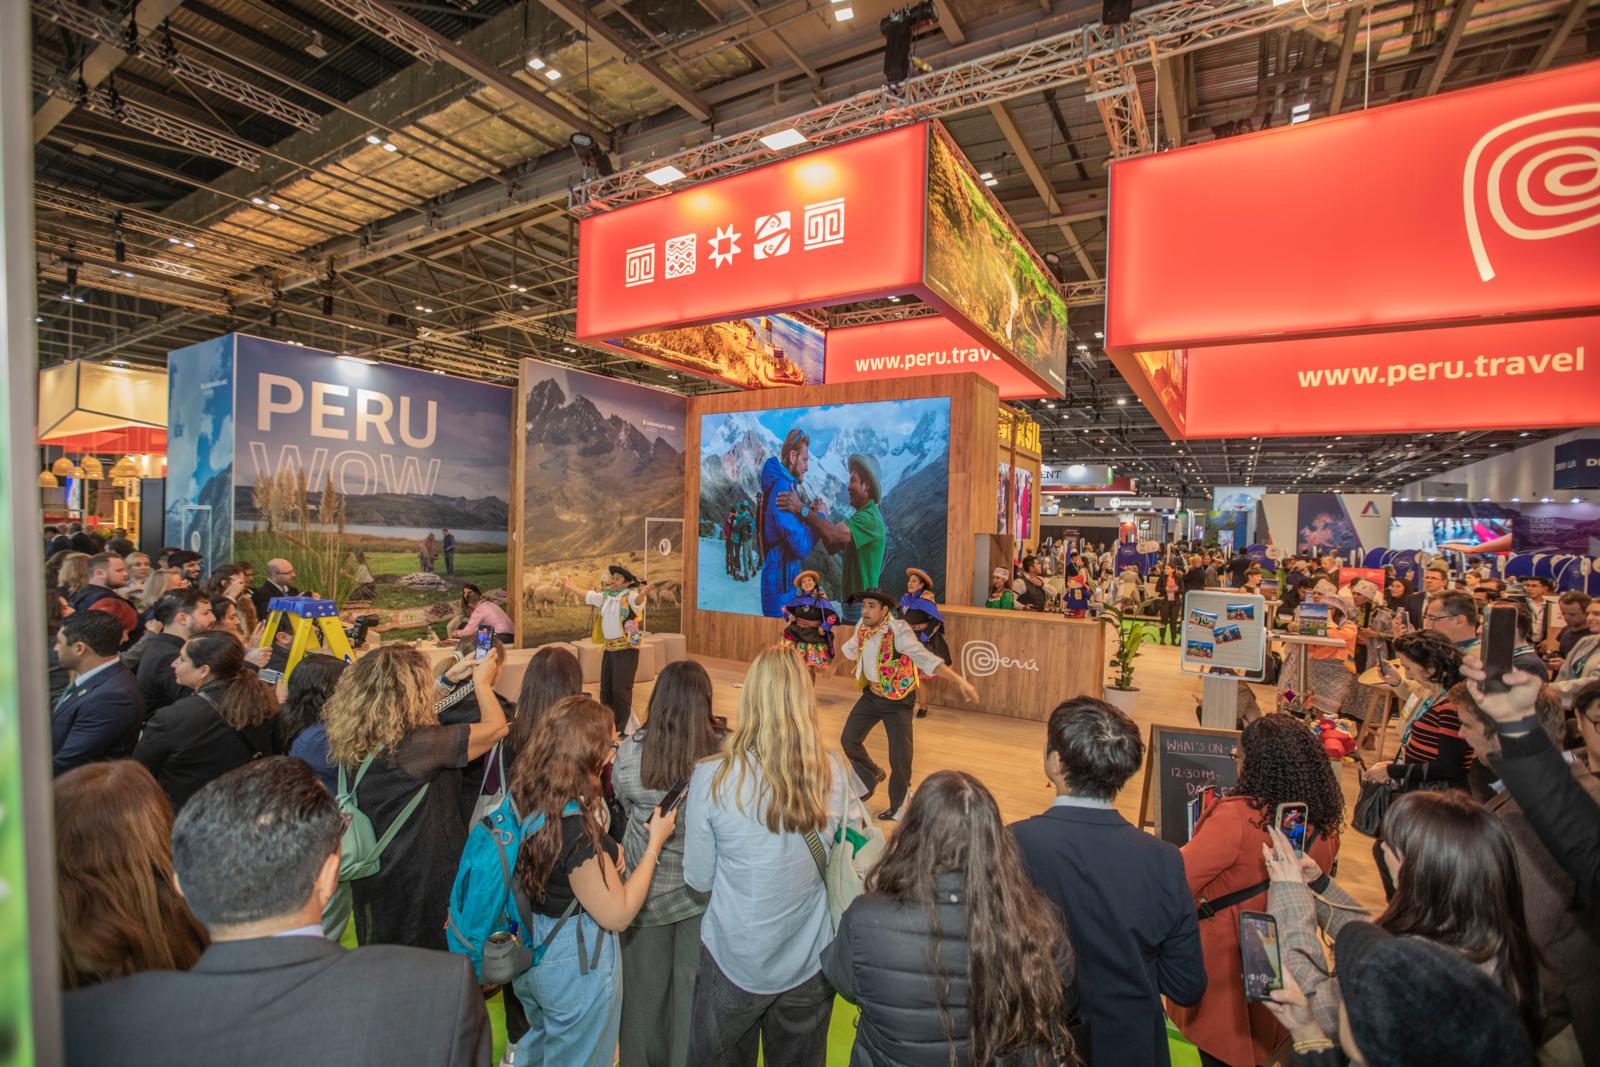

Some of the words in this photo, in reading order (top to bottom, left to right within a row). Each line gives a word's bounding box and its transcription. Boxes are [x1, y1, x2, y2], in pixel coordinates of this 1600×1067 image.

[1297, 346, 1584, 388] www.peru.travel
[257, 372, 438, 449] PERU
[248, 440, 441, 497] WOW
[1166, 738, 1205, 752] WHAT'S
